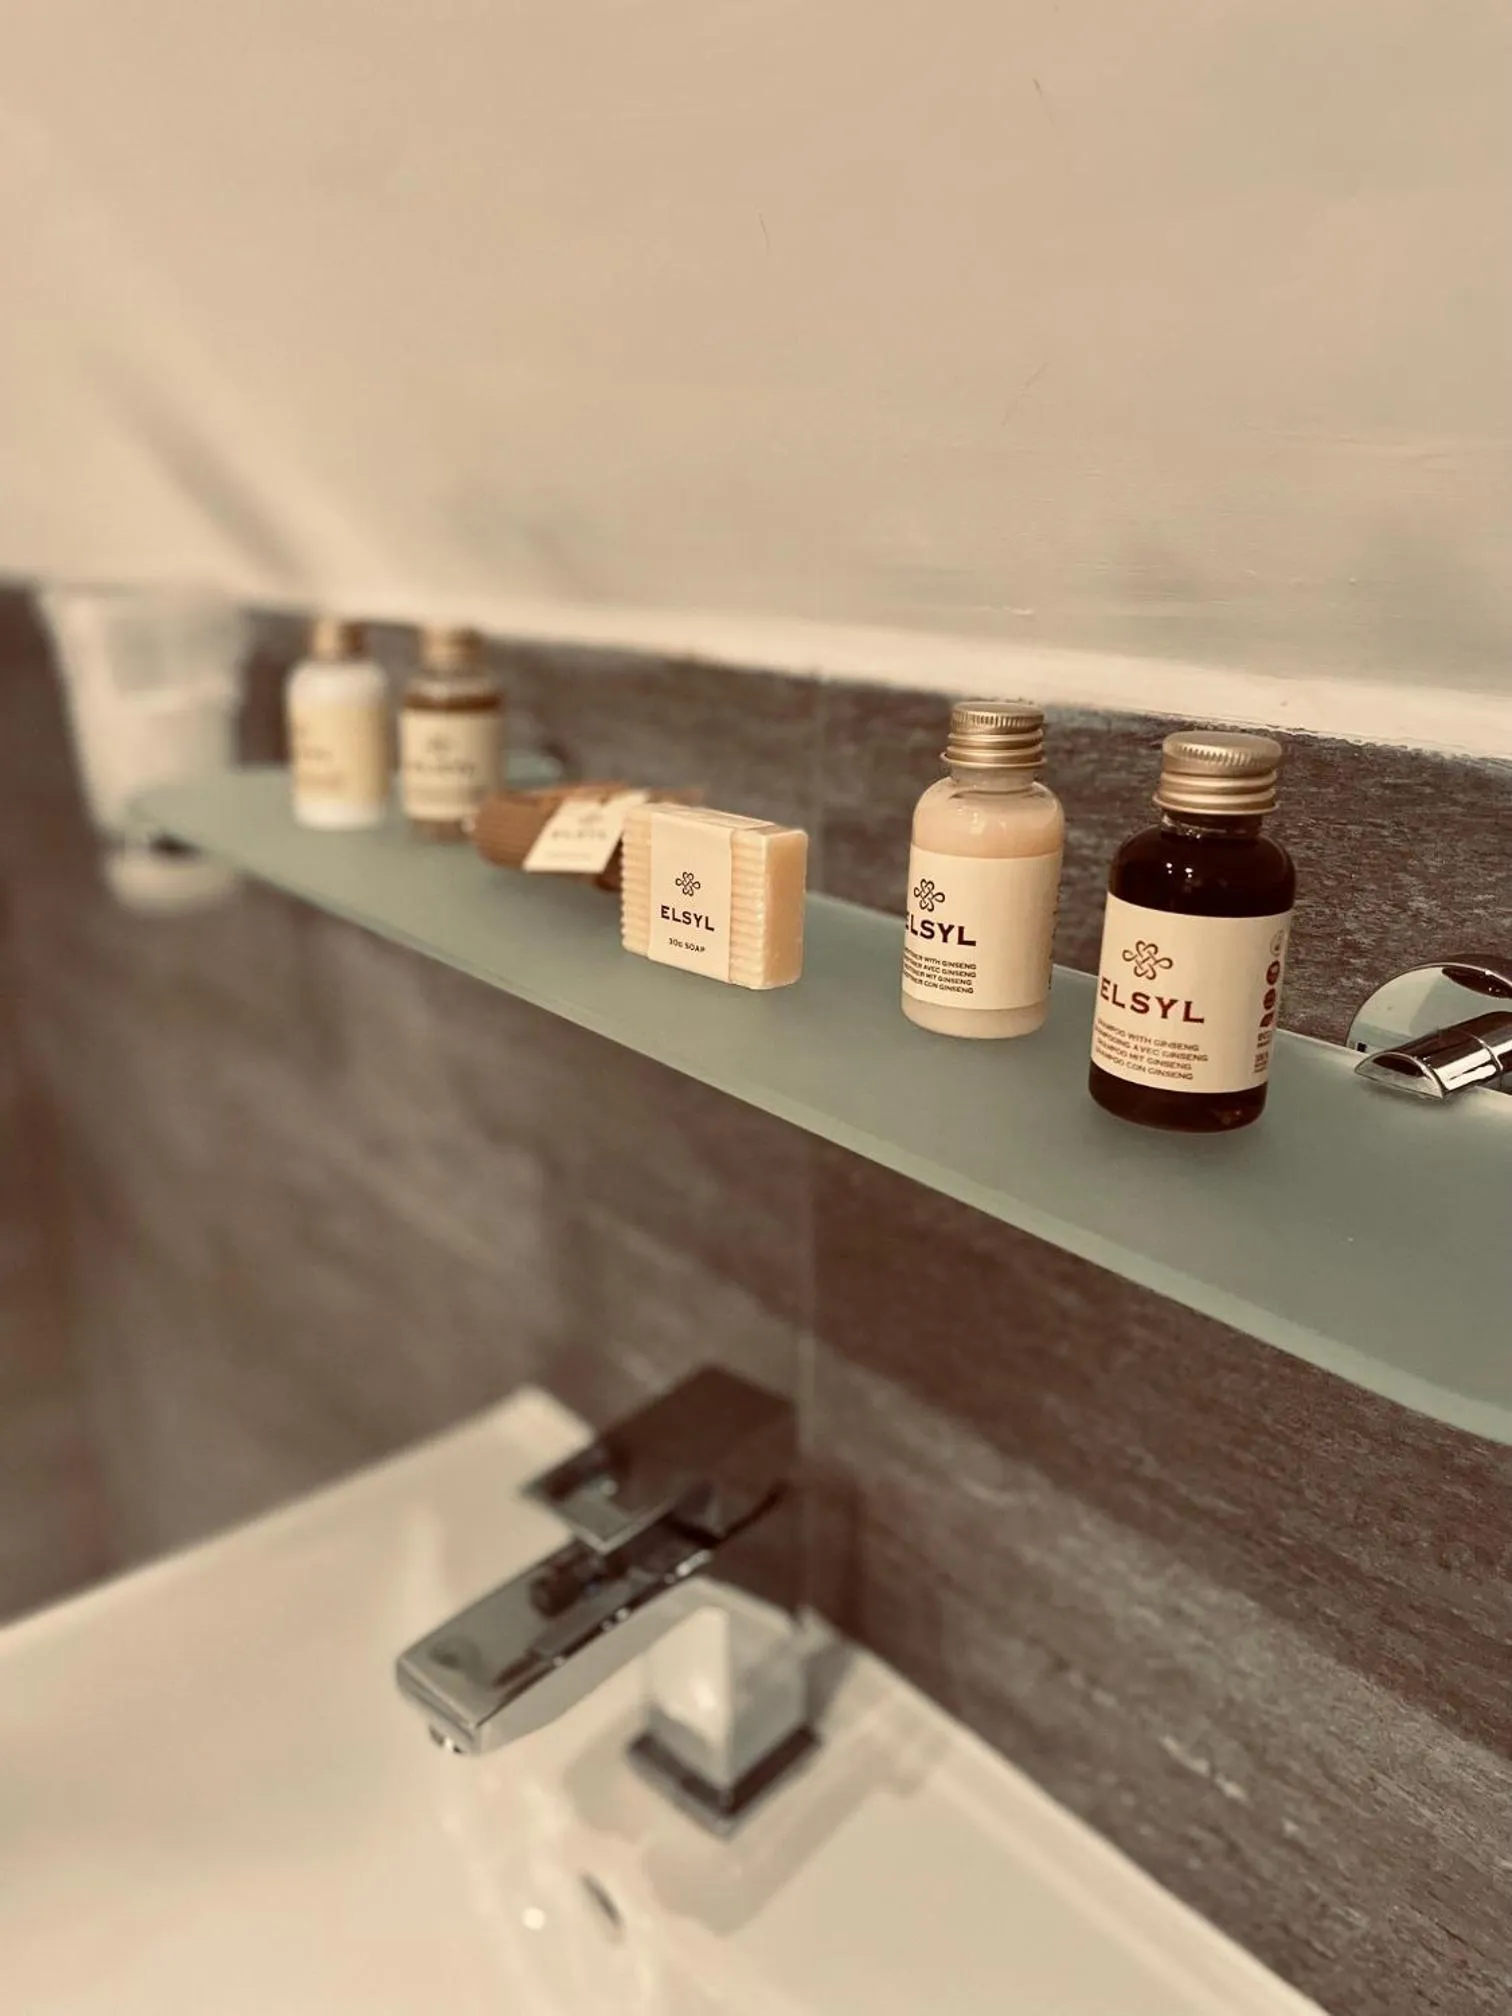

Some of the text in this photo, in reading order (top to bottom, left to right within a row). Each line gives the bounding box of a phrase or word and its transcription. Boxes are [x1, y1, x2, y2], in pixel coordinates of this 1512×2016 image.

[661, 905, 715, 932] ELSYL
[685, 942, 706, 953] SOAP
[1100, 976, 1205, 1024] ELSYL
[1127, 1032, 1152, 1044] WITH
[1152, 1038, 1200, 1052] GINSENG
[1129, 1052, 1145, 1062] MIT
[1146, 1057, 1193, 1071] GINSENG
[1133, 1044, 1160, 1056] AVEC
[1162, 1050, 1209, 1062] GINSENG
[1126, 1060, 1147, 1073] CON
[1148, 1066, 1194, 1081] GINSENG
